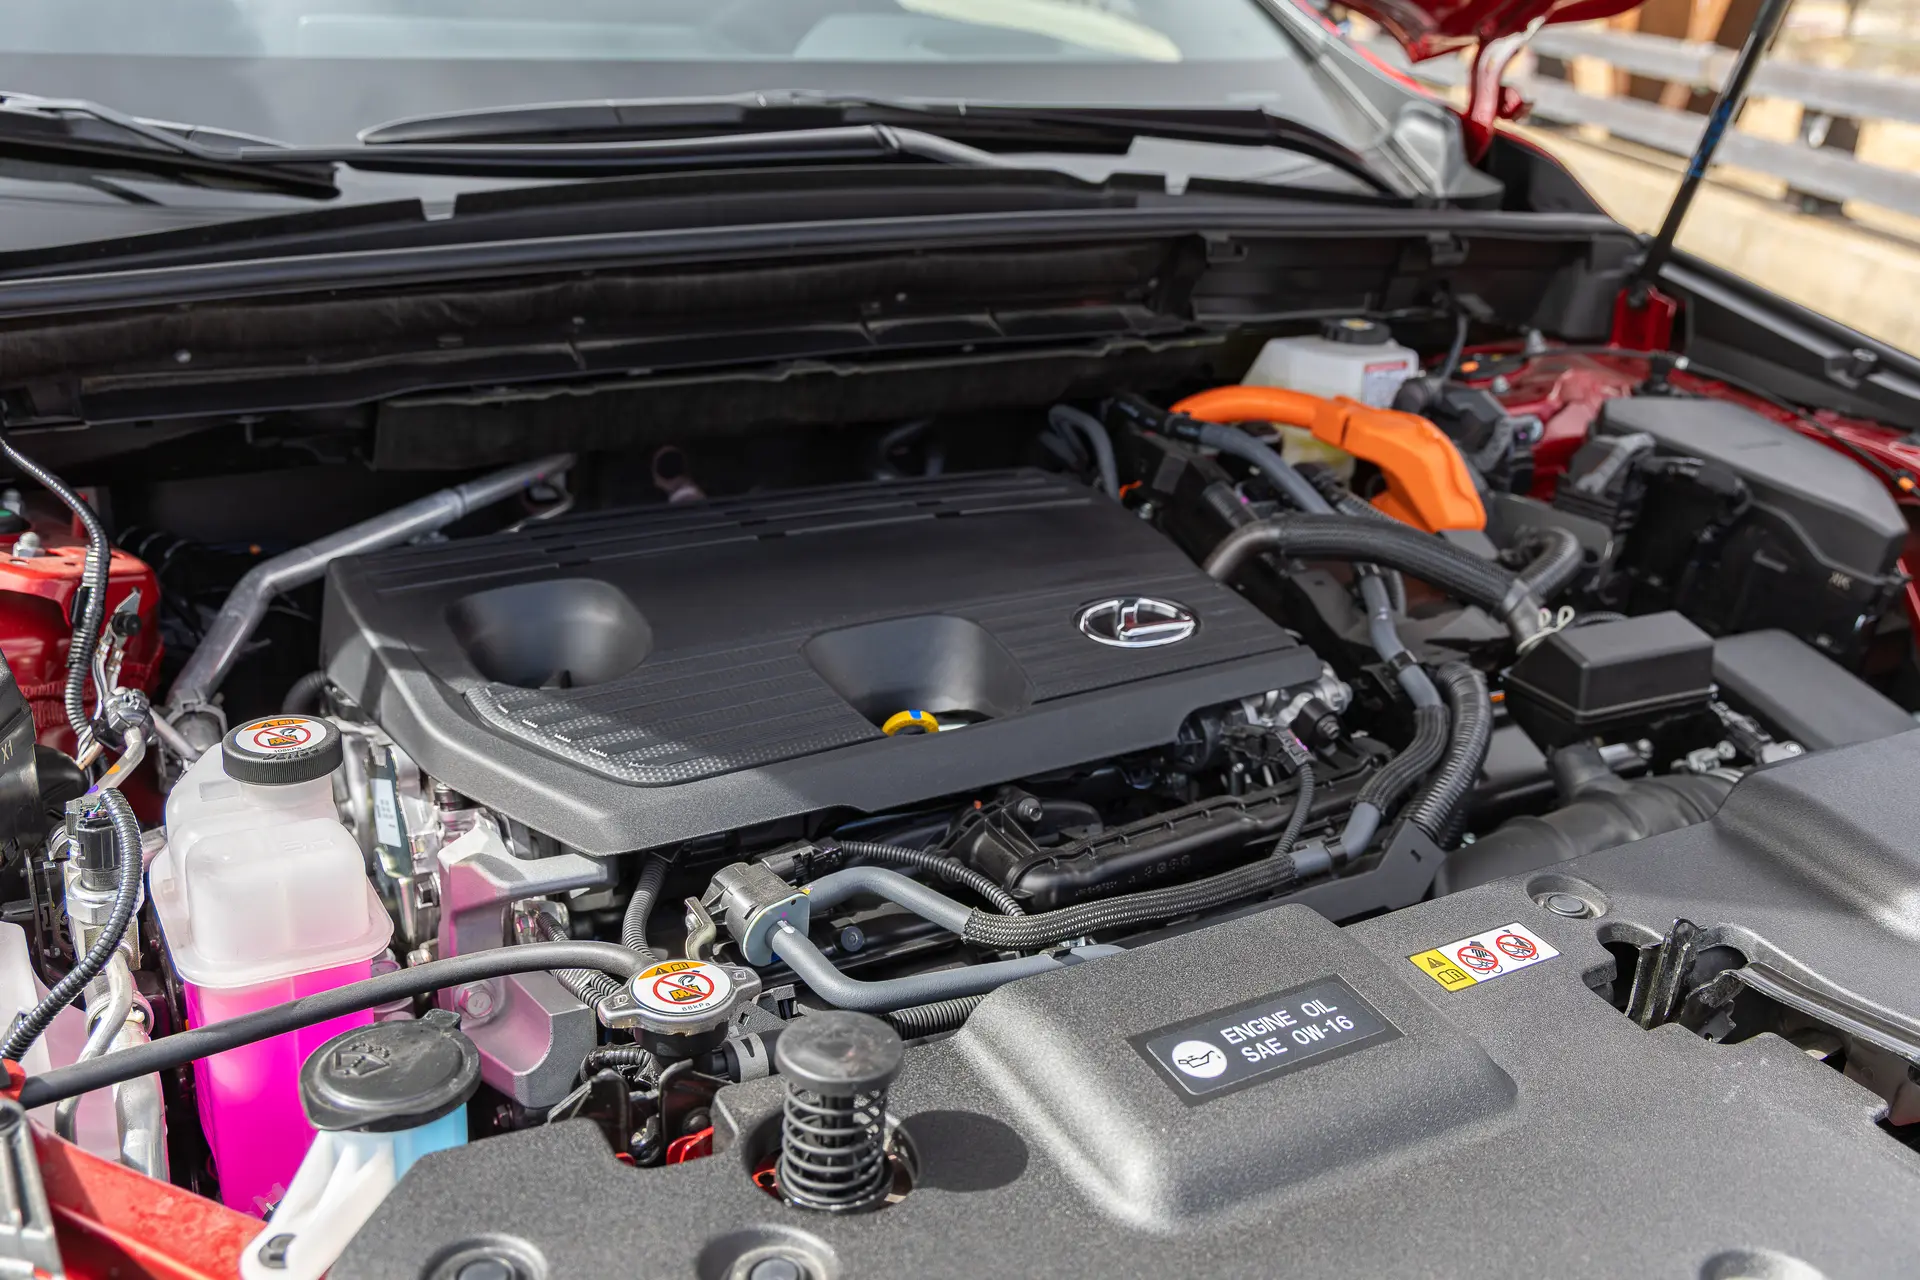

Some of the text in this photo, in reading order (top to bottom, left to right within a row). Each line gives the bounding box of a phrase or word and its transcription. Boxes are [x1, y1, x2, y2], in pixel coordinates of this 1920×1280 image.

[681, 1002, 711, 1012] 88kPa
[1220, 999, 1338, 1045] ENGINE OIL
[1240, 1015, 1355, 1063] SAE 0W-16
